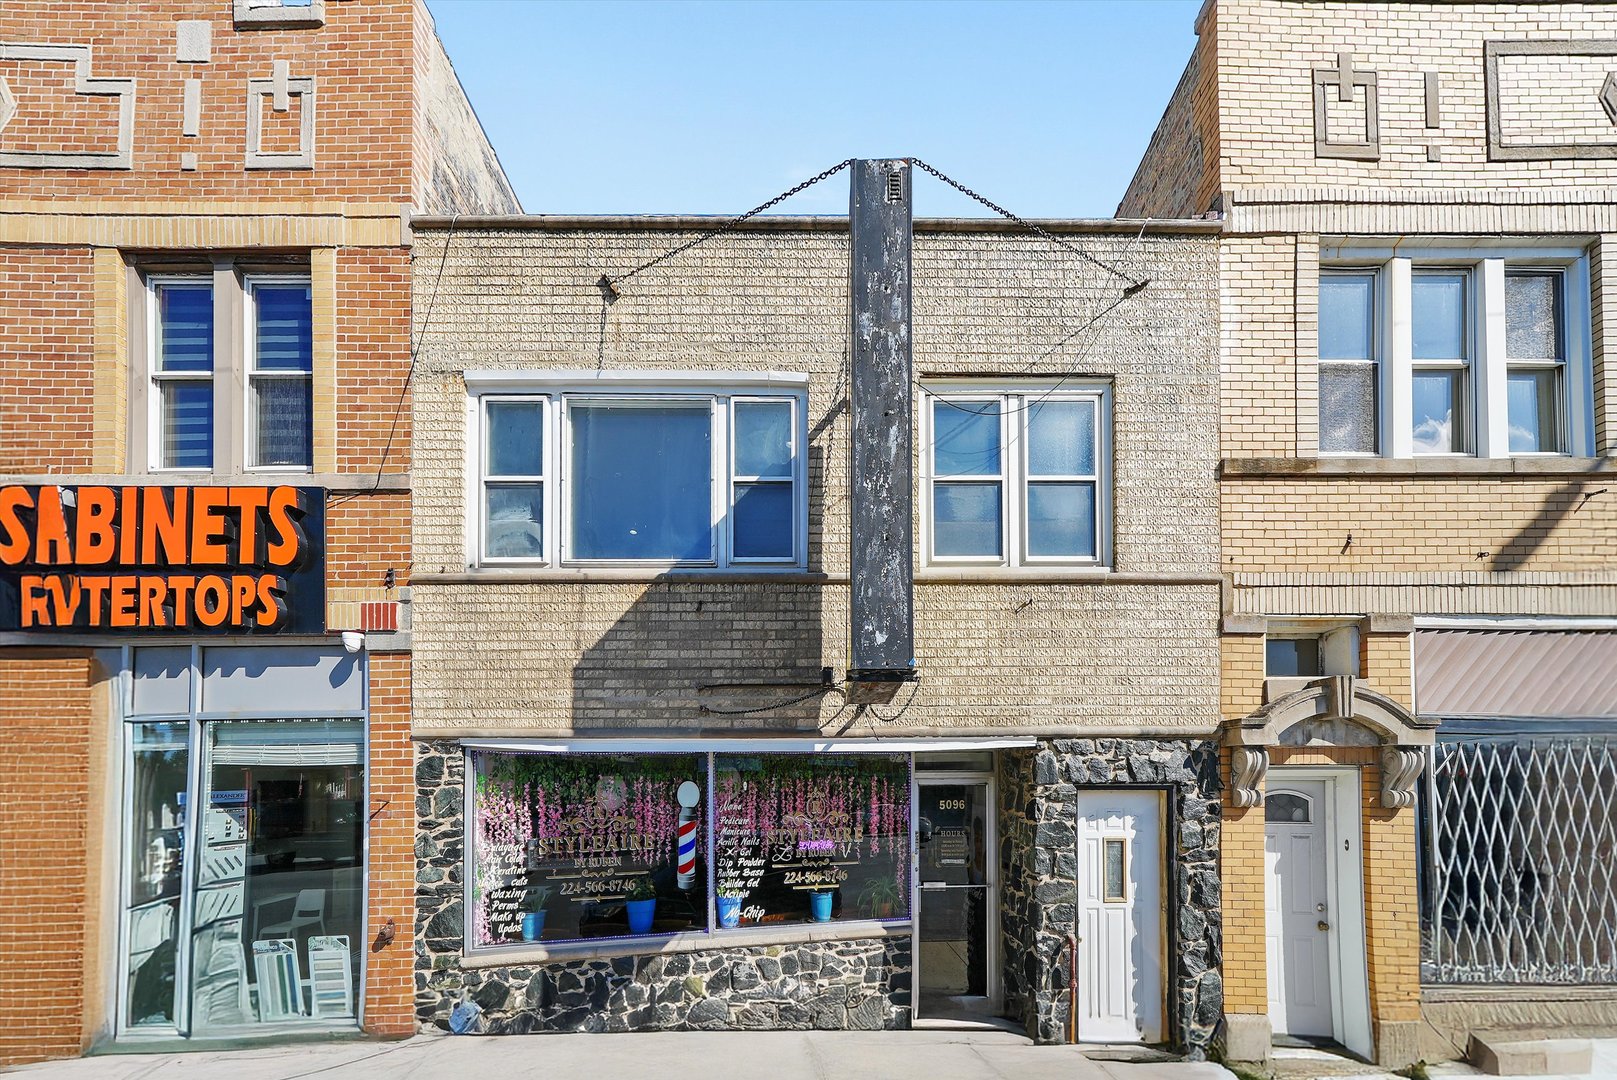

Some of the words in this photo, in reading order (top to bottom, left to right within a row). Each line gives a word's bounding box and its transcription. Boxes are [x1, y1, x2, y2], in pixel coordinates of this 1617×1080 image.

[939, 799, 965, 810] 5096
[740, 836, 760, 846] Nails
[767, 827, 864, 845] STYLEAIRE
[539, 832, 655, 855] STYLEAIRE
[718, 857, 733, 870] Dip
[738, 857, 766, 867] Powder
[717, 867, 740, 877] Rubber
[742, 867, 765, 877] Base
[784, 869, 848, 884] 224-566-8746
[560, 879, 636, 895] 224-566-8746
[718, 878, 746, 888] Builder
[747, 878, 761, 888] Gel
[492, 900, 518, 911] Perms
[516, 911, 526, 923] up
[498, 922, 523, 937] Updos
